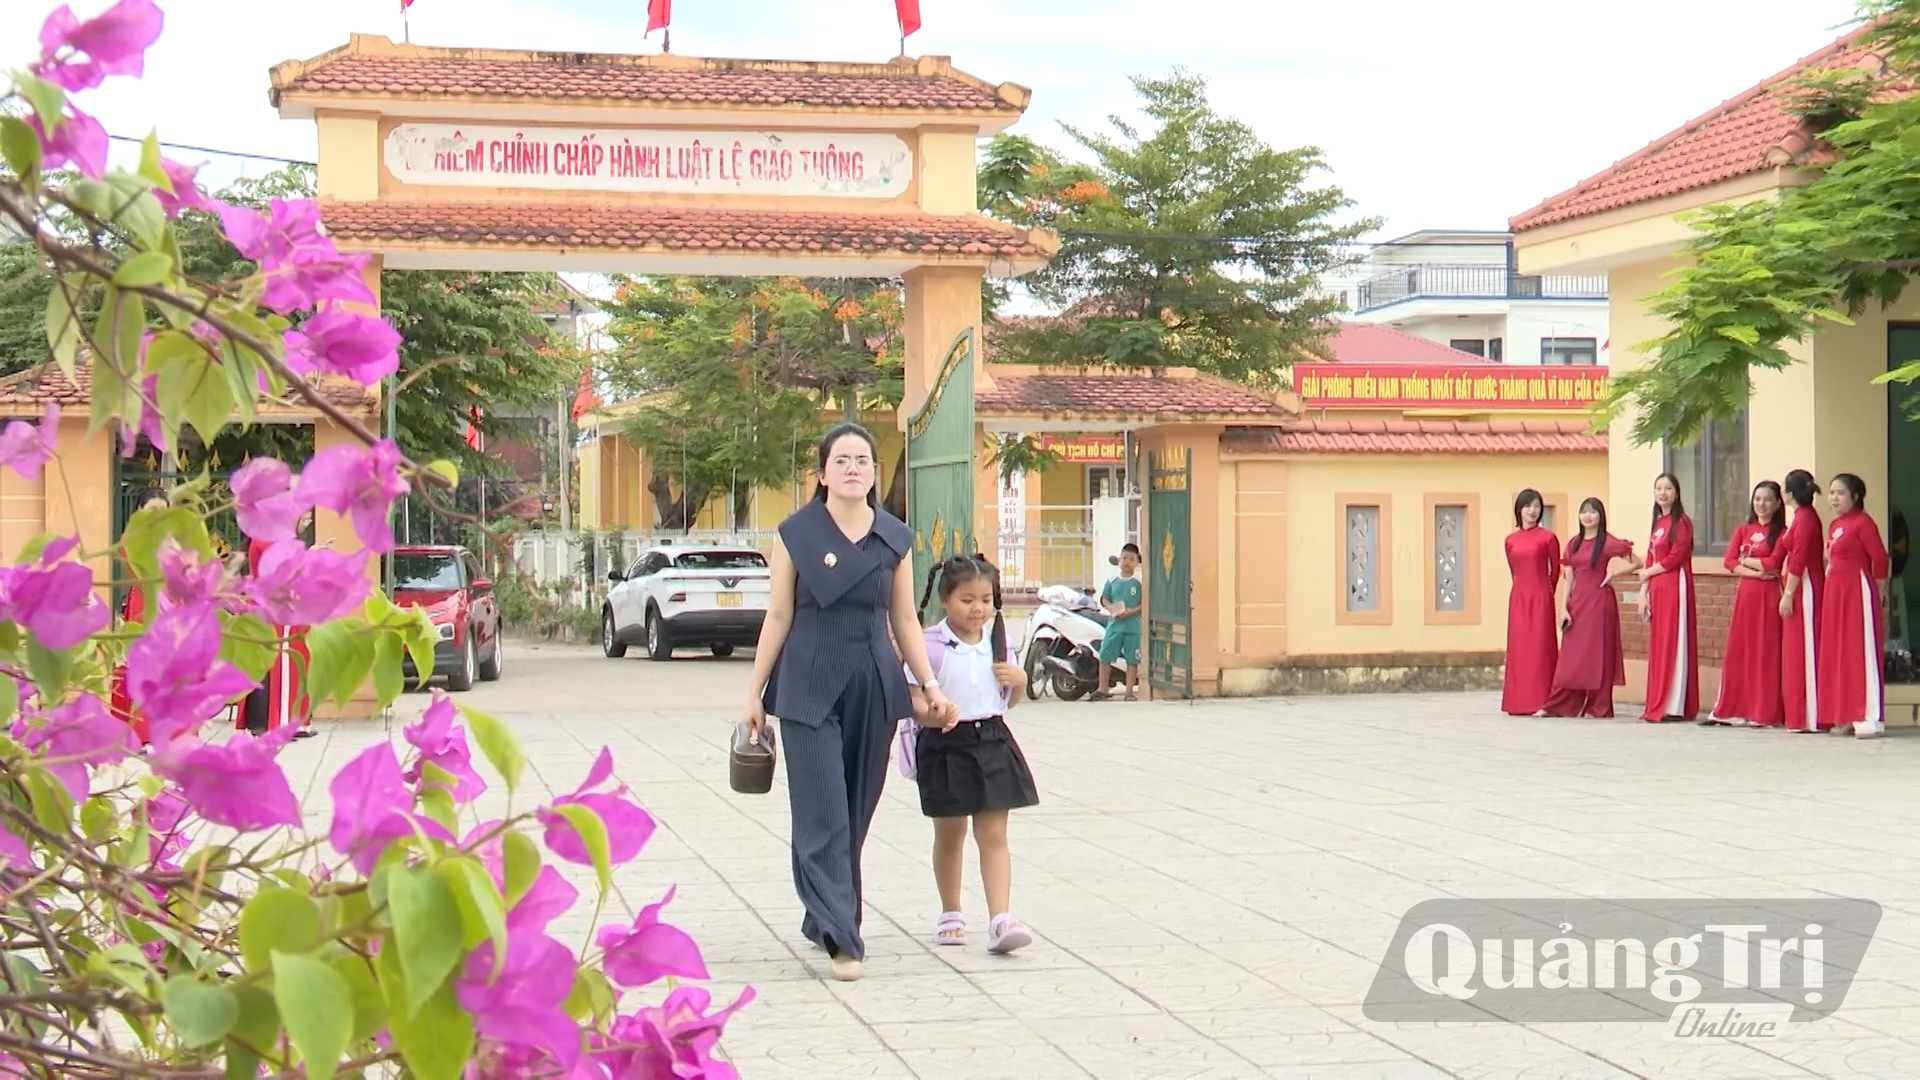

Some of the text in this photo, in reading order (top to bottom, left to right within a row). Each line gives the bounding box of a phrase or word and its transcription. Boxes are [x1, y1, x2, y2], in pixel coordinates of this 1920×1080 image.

[406, 131, 864, 186] HIÊM CHỈNH CHẤP HÀNH LUẬT LỆ GIAO THÔNG
[1302, 369, 1320, 398] GIẢI
[1321, 373, 1352, 398] PHÓNG
[1378, 377, 1399, 398] NAM
[1401, 370, 1430, 400] THỐNG
[1431, 370, 1454, 400] NHẤT
[1499, 374, 1528, 400] THÀNH
[1529, 371, 1547, 402] QUẢ
[1548, 375, 1558, 400] VĨ
[1574, 371, 1592, 400] CỦA
[1067, 443, 1086, 460] TỊCH
